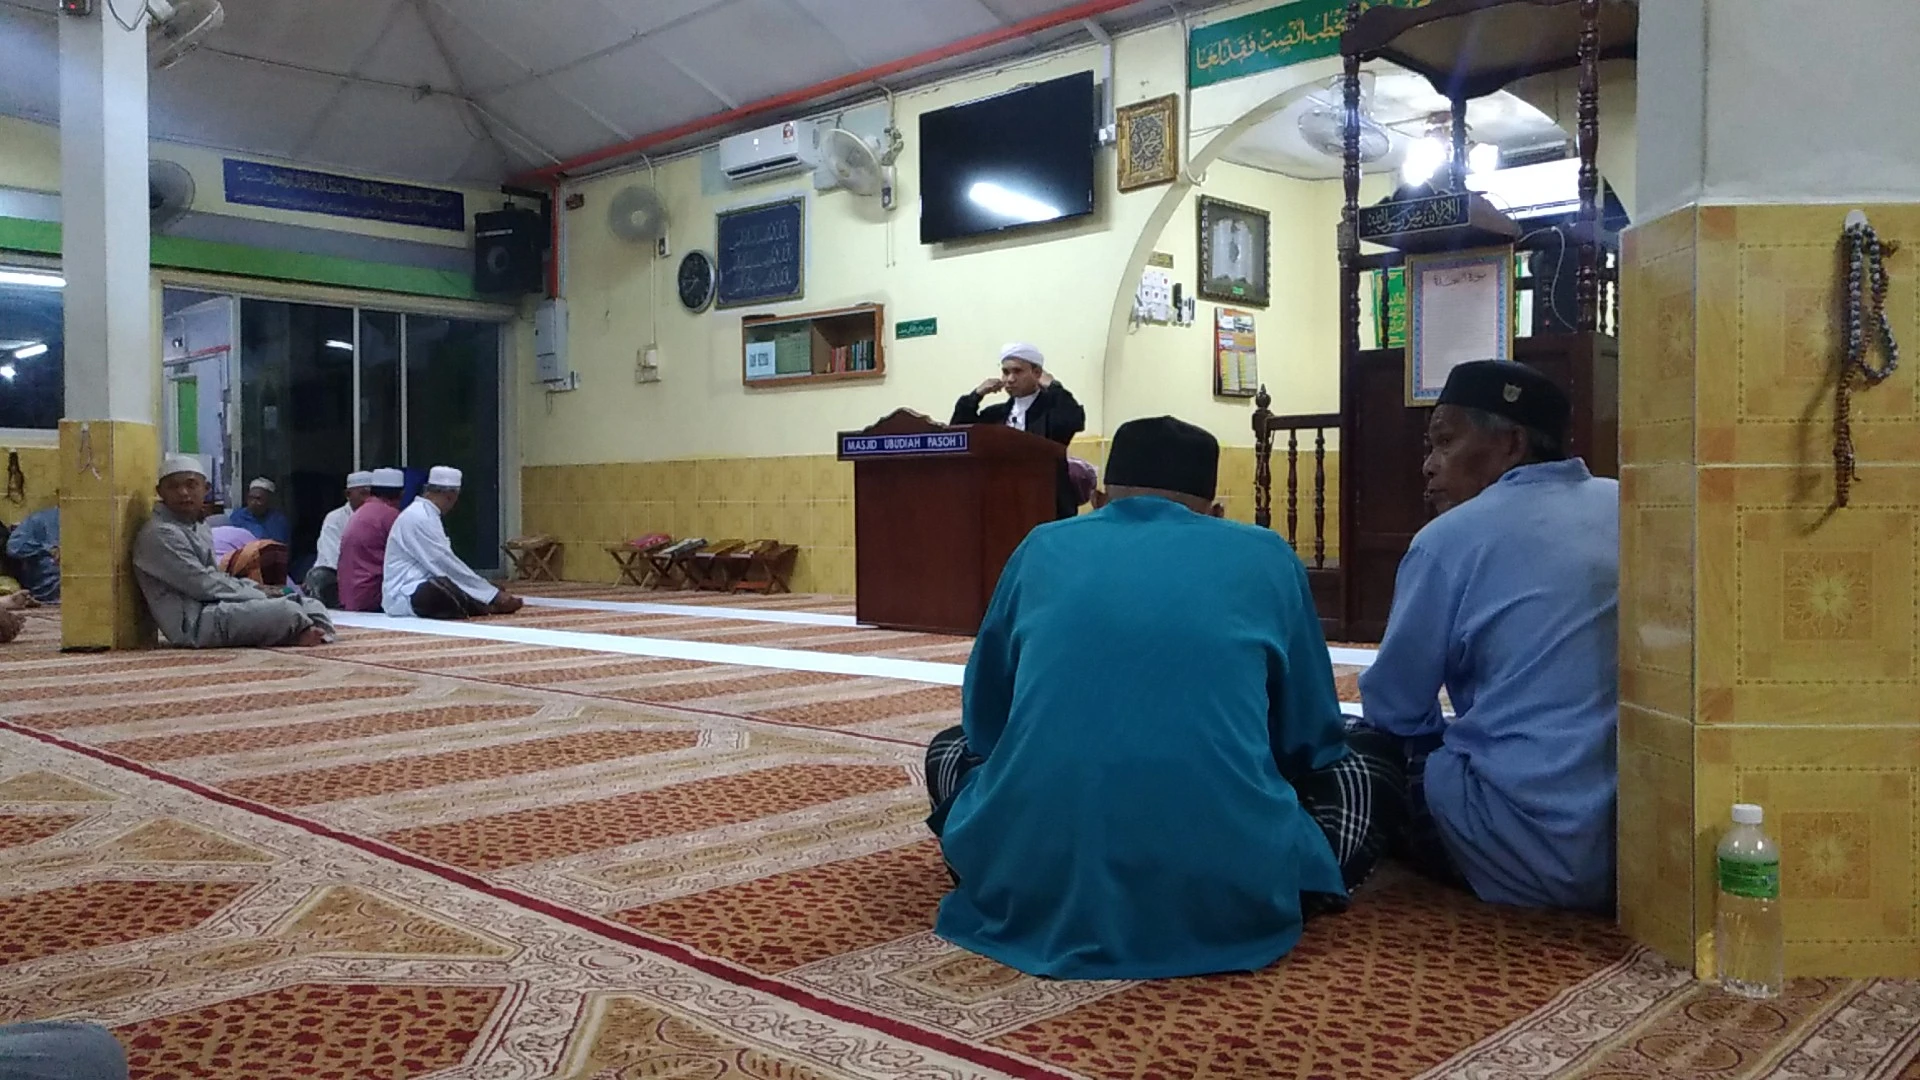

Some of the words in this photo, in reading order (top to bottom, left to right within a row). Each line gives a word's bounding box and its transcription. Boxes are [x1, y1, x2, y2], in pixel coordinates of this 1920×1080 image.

[847, 439, 877, 451] MASJID
[884, 437, 921, 449] UBUDIAH
[927, 436, 956, 448] PASOH
